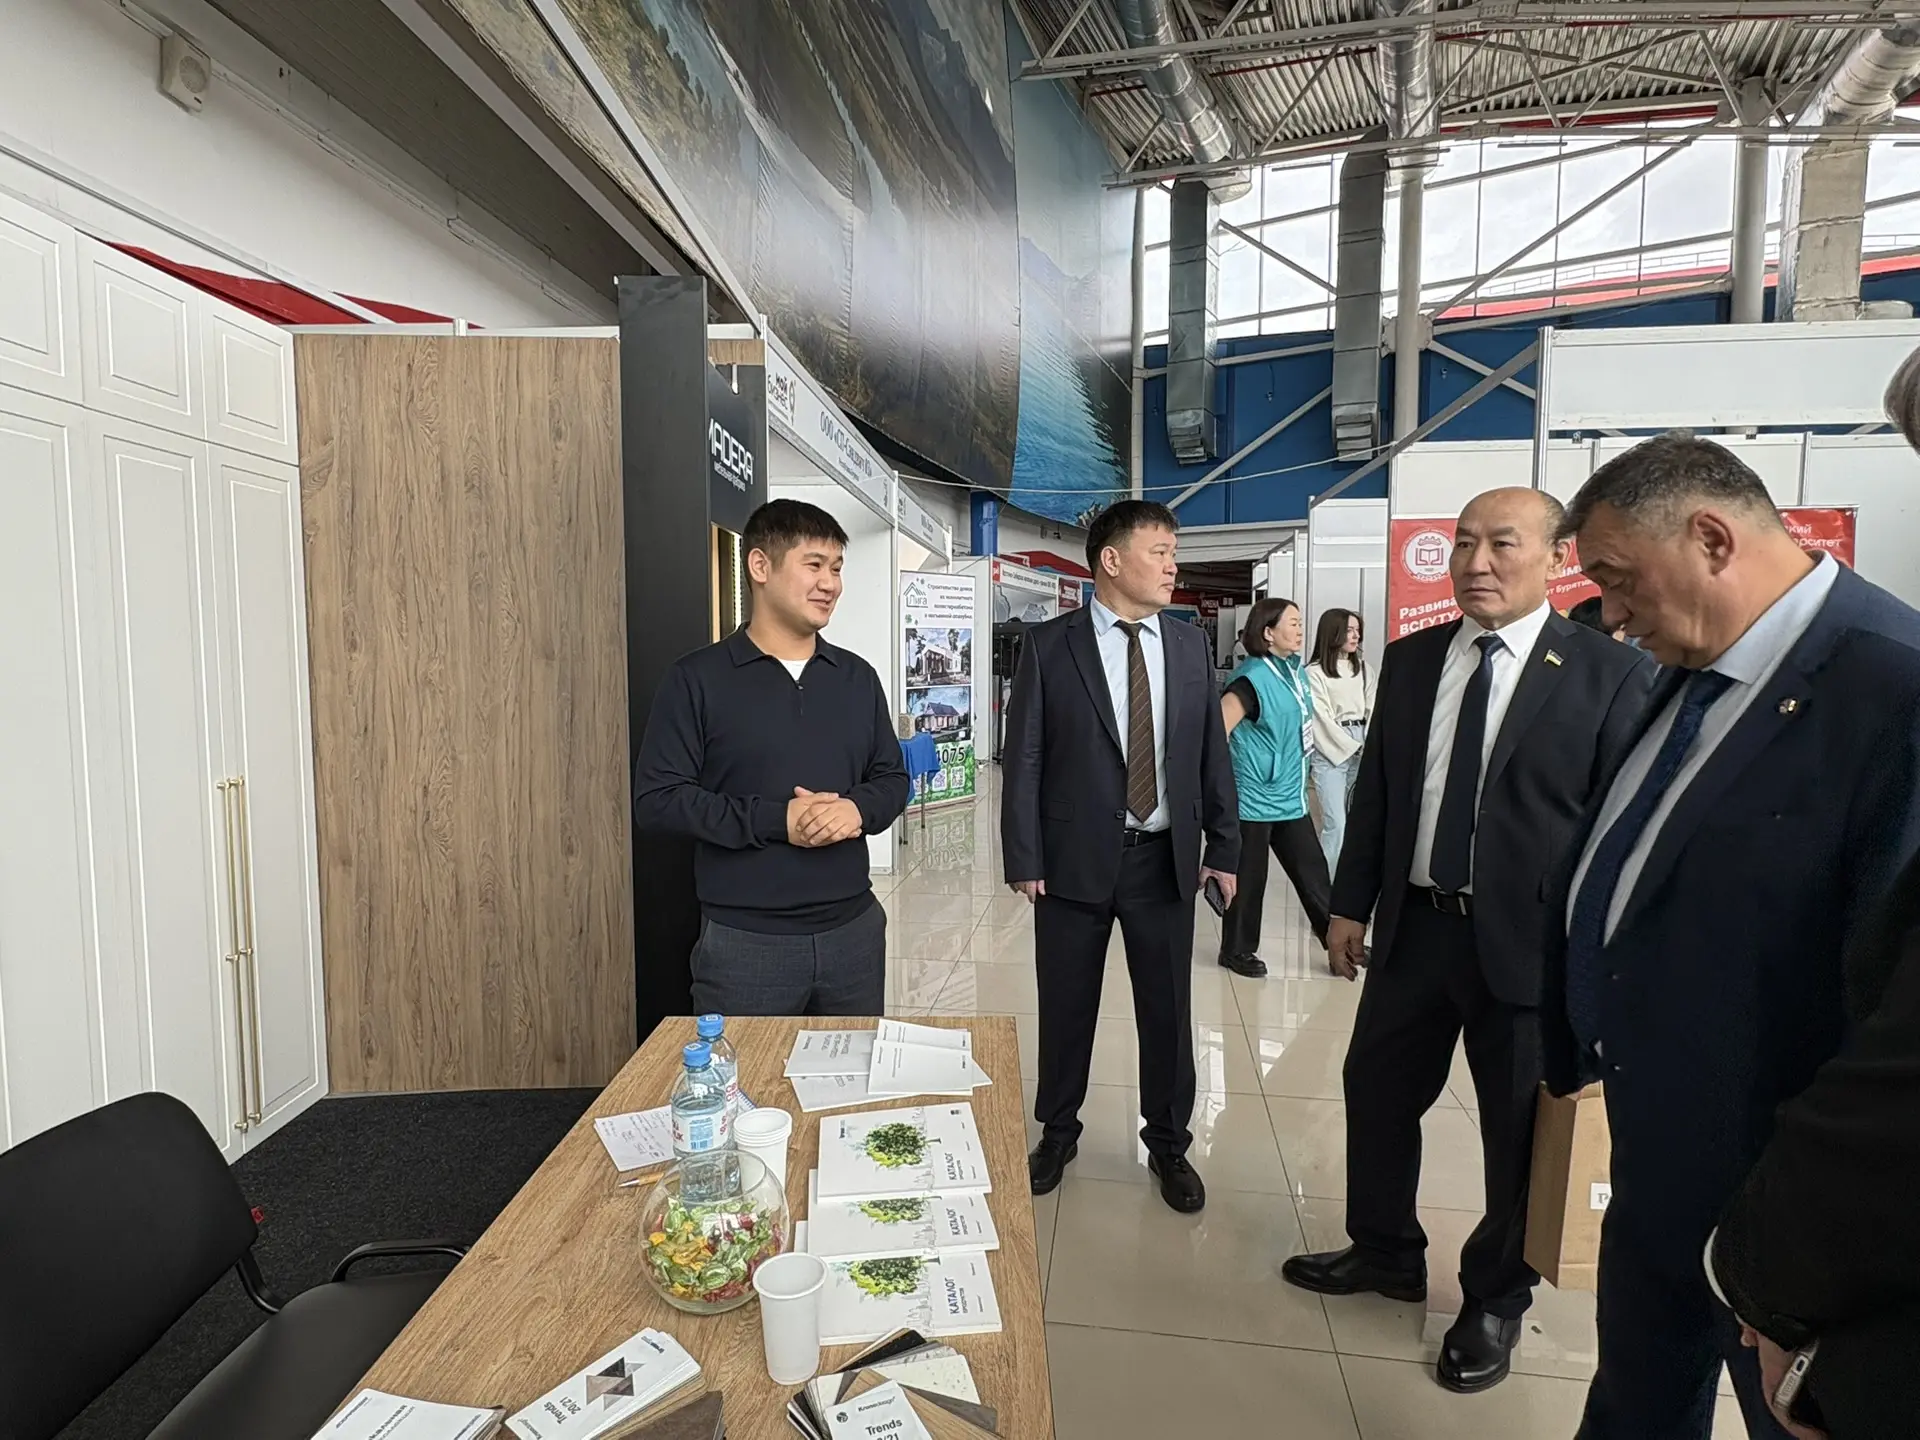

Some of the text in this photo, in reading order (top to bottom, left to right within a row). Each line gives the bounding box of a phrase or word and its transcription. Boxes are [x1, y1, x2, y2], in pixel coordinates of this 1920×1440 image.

[944, 1152, 958, 1181] КАТАЛОГ
[945, 1207, 961, 1236] КАТАЛОГ
[944, 1277, 960, 1315] КАТАЛОГ
[543, 1401, 568, 1424] Trends
[559, 1396, 581, 1415] 20/21
[865, 1419, 903, 1436] Trends
